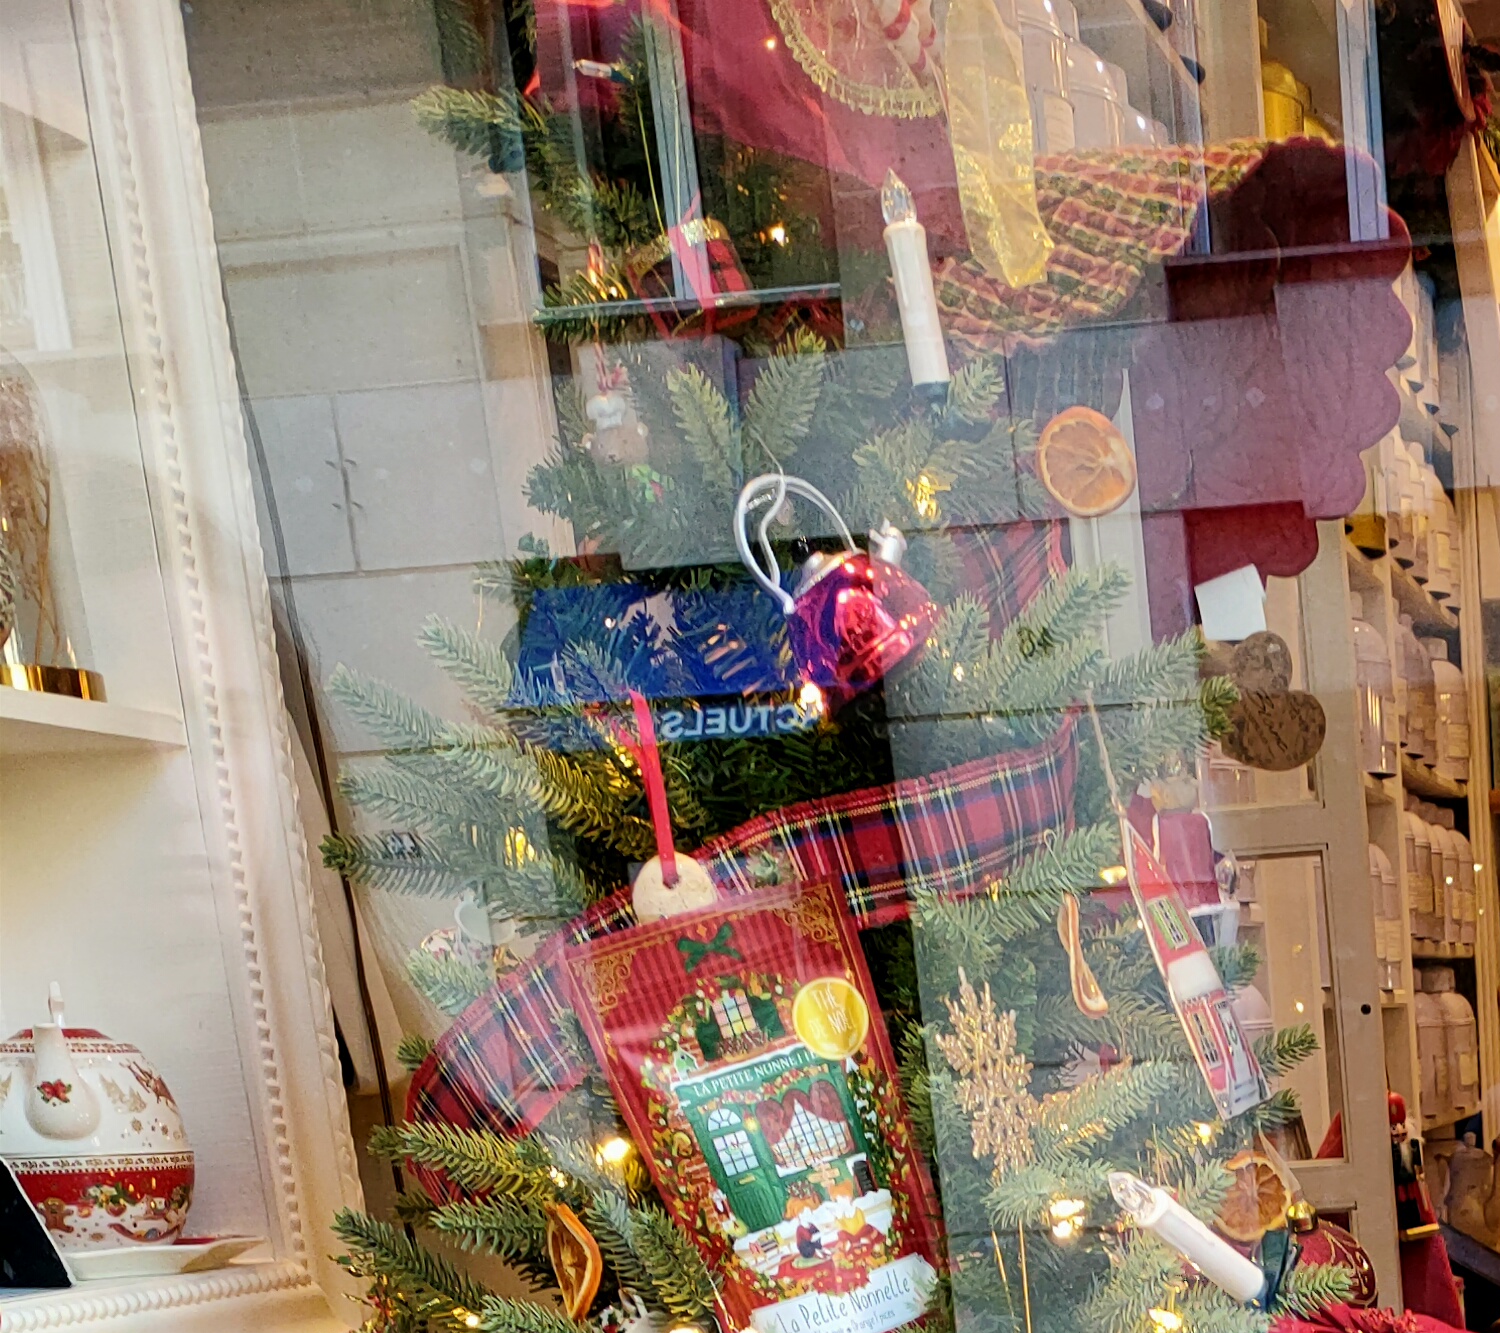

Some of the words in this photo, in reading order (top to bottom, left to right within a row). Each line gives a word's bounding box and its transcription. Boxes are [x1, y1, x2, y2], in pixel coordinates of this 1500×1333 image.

[694, 1083, 712, 1098] LA
[711, 1069, 754, 1092] PETITE
[799, 1295, 849, 1331] Petite
[849, 1268, 911, 1315] Nonnette
